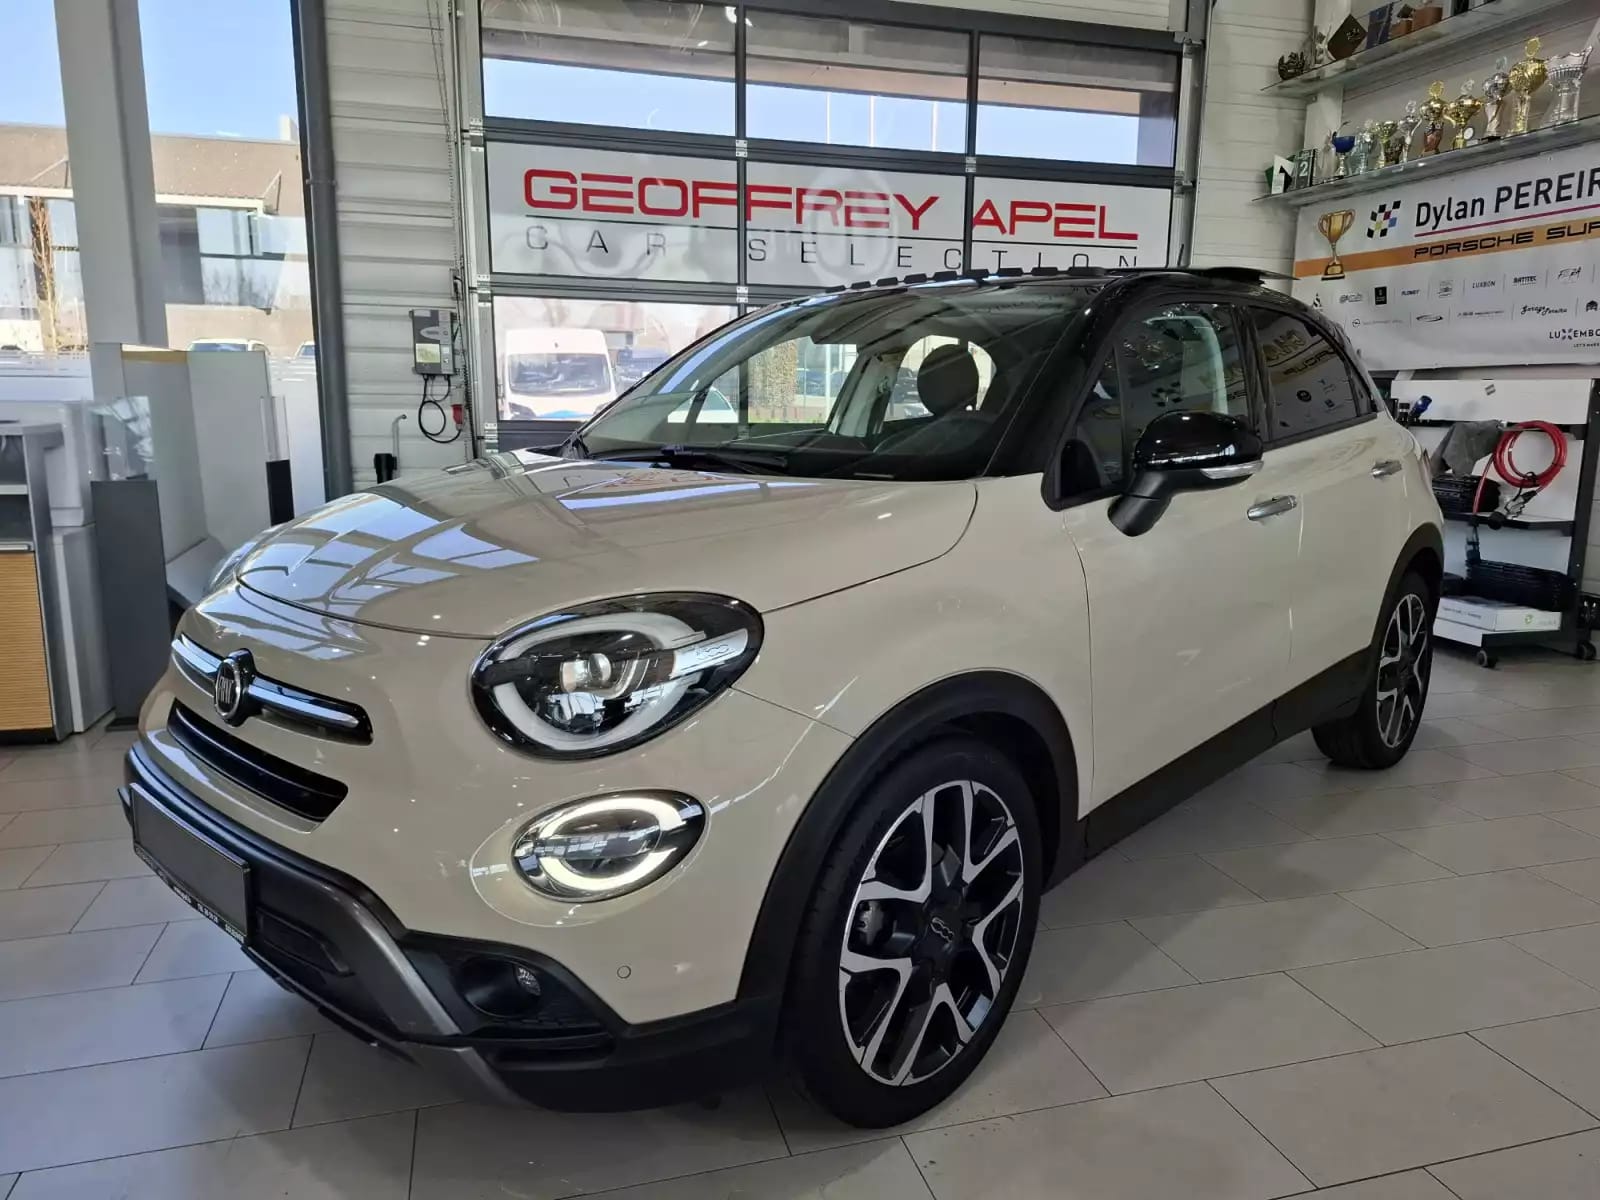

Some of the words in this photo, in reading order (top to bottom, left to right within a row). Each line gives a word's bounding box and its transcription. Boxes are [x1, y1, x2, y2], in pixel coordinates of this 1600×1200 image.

[524, 168, 940, 231] GEOFFREY
[972, 198, 1139, 240] APEL
[1415, 197, 1485, 230] Dylan
[1494, 167, 1600, 213] PEREIR
[526, 225, 666, 256] CAR
[748, 238, 1137, 270] SELECTION
[1414, 231, 1535, 259] PORSCHE
[1520, 304, 1546, 316] Garage
[218, 675, 235, 704] FIAT
